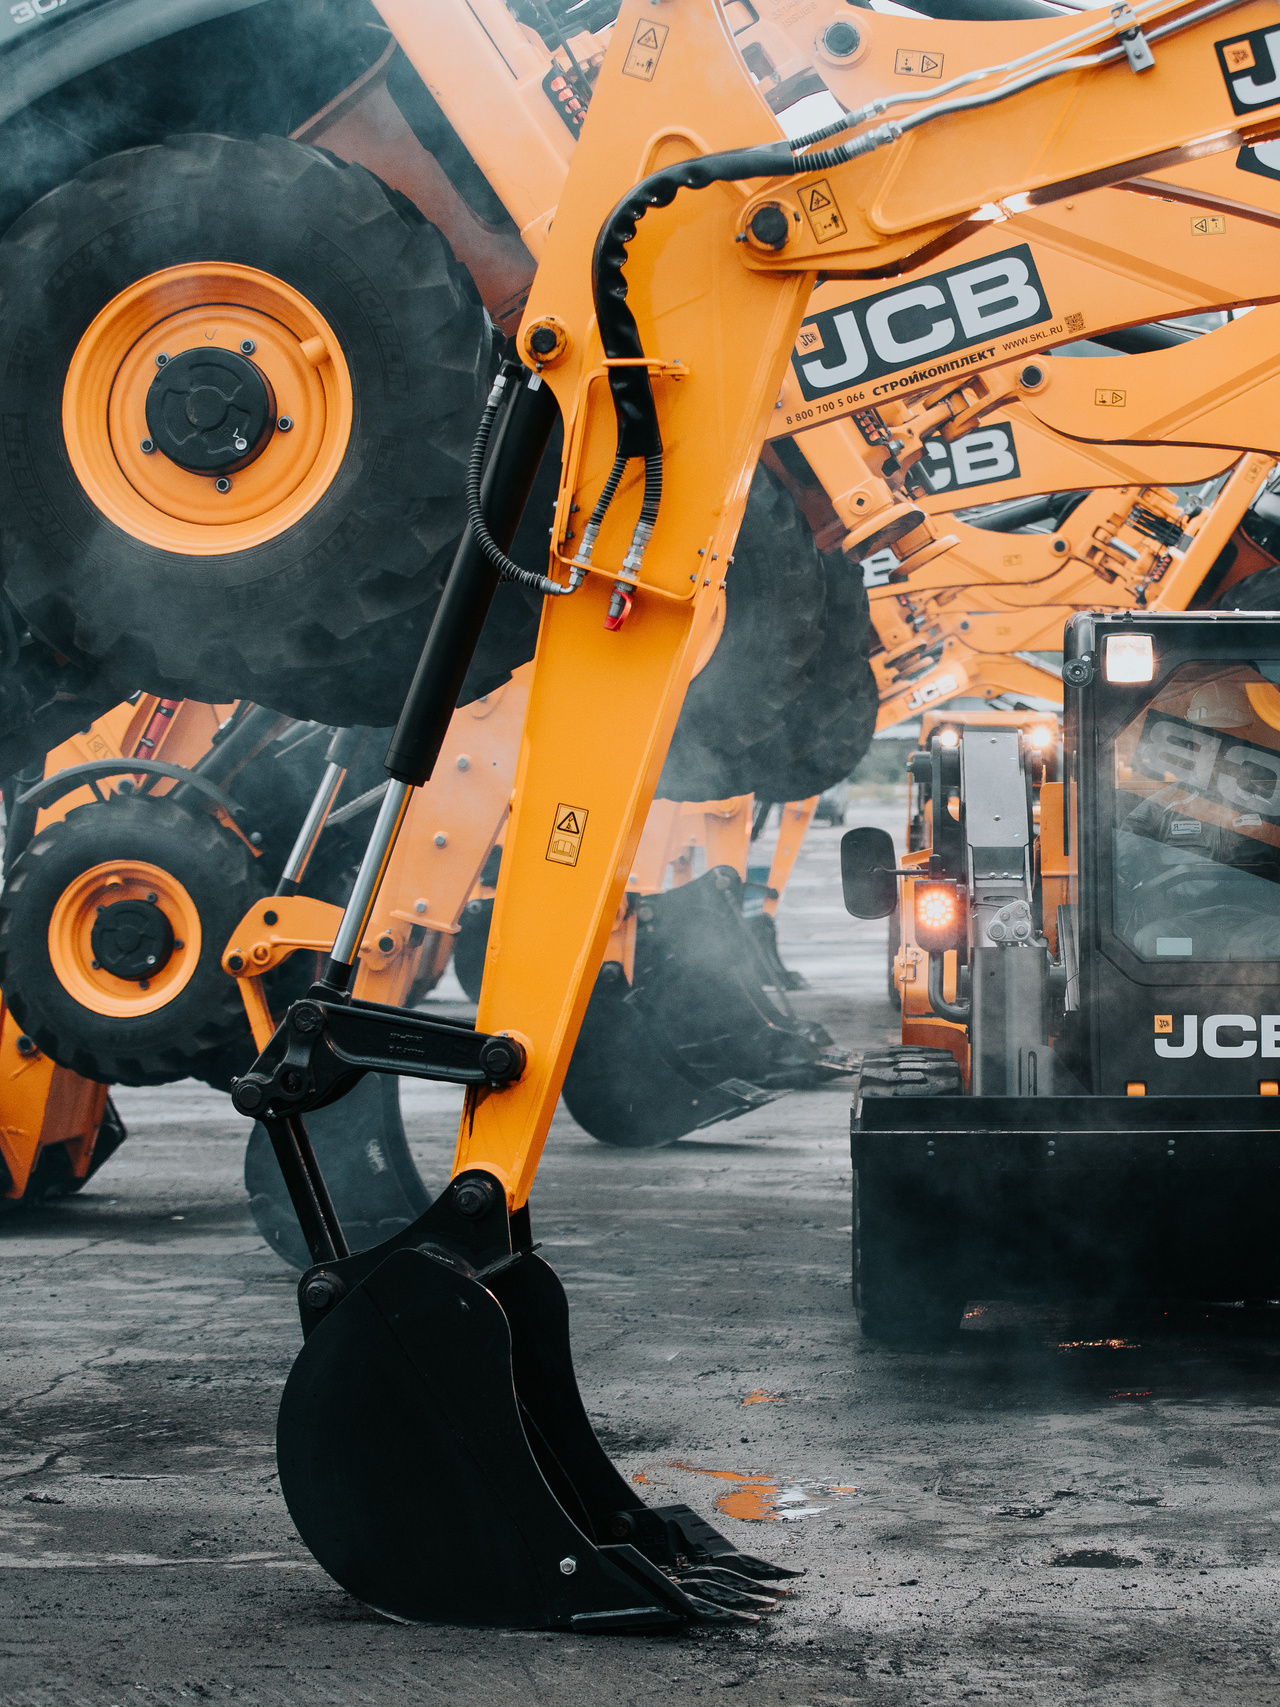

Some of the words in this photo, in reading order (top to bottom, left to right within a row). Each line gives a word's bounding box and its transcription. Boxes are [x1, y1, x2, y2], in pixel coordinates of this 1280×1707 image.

[800, 333, 816, 346] JCB
[802, 257, 1040, 388] JCB
[786, 416, 793, 424] 8
[795, 409, 813, 421] 800
[816, 401, 835, 414] 700
[837, 398, 844, 407] 5
[846, 391, 865, 404] 066
[872, 347, 996, 396] СТРОЙКОМПЛЕКТ
[1002, 325, 1063, 351] WWW.SKL.RU
